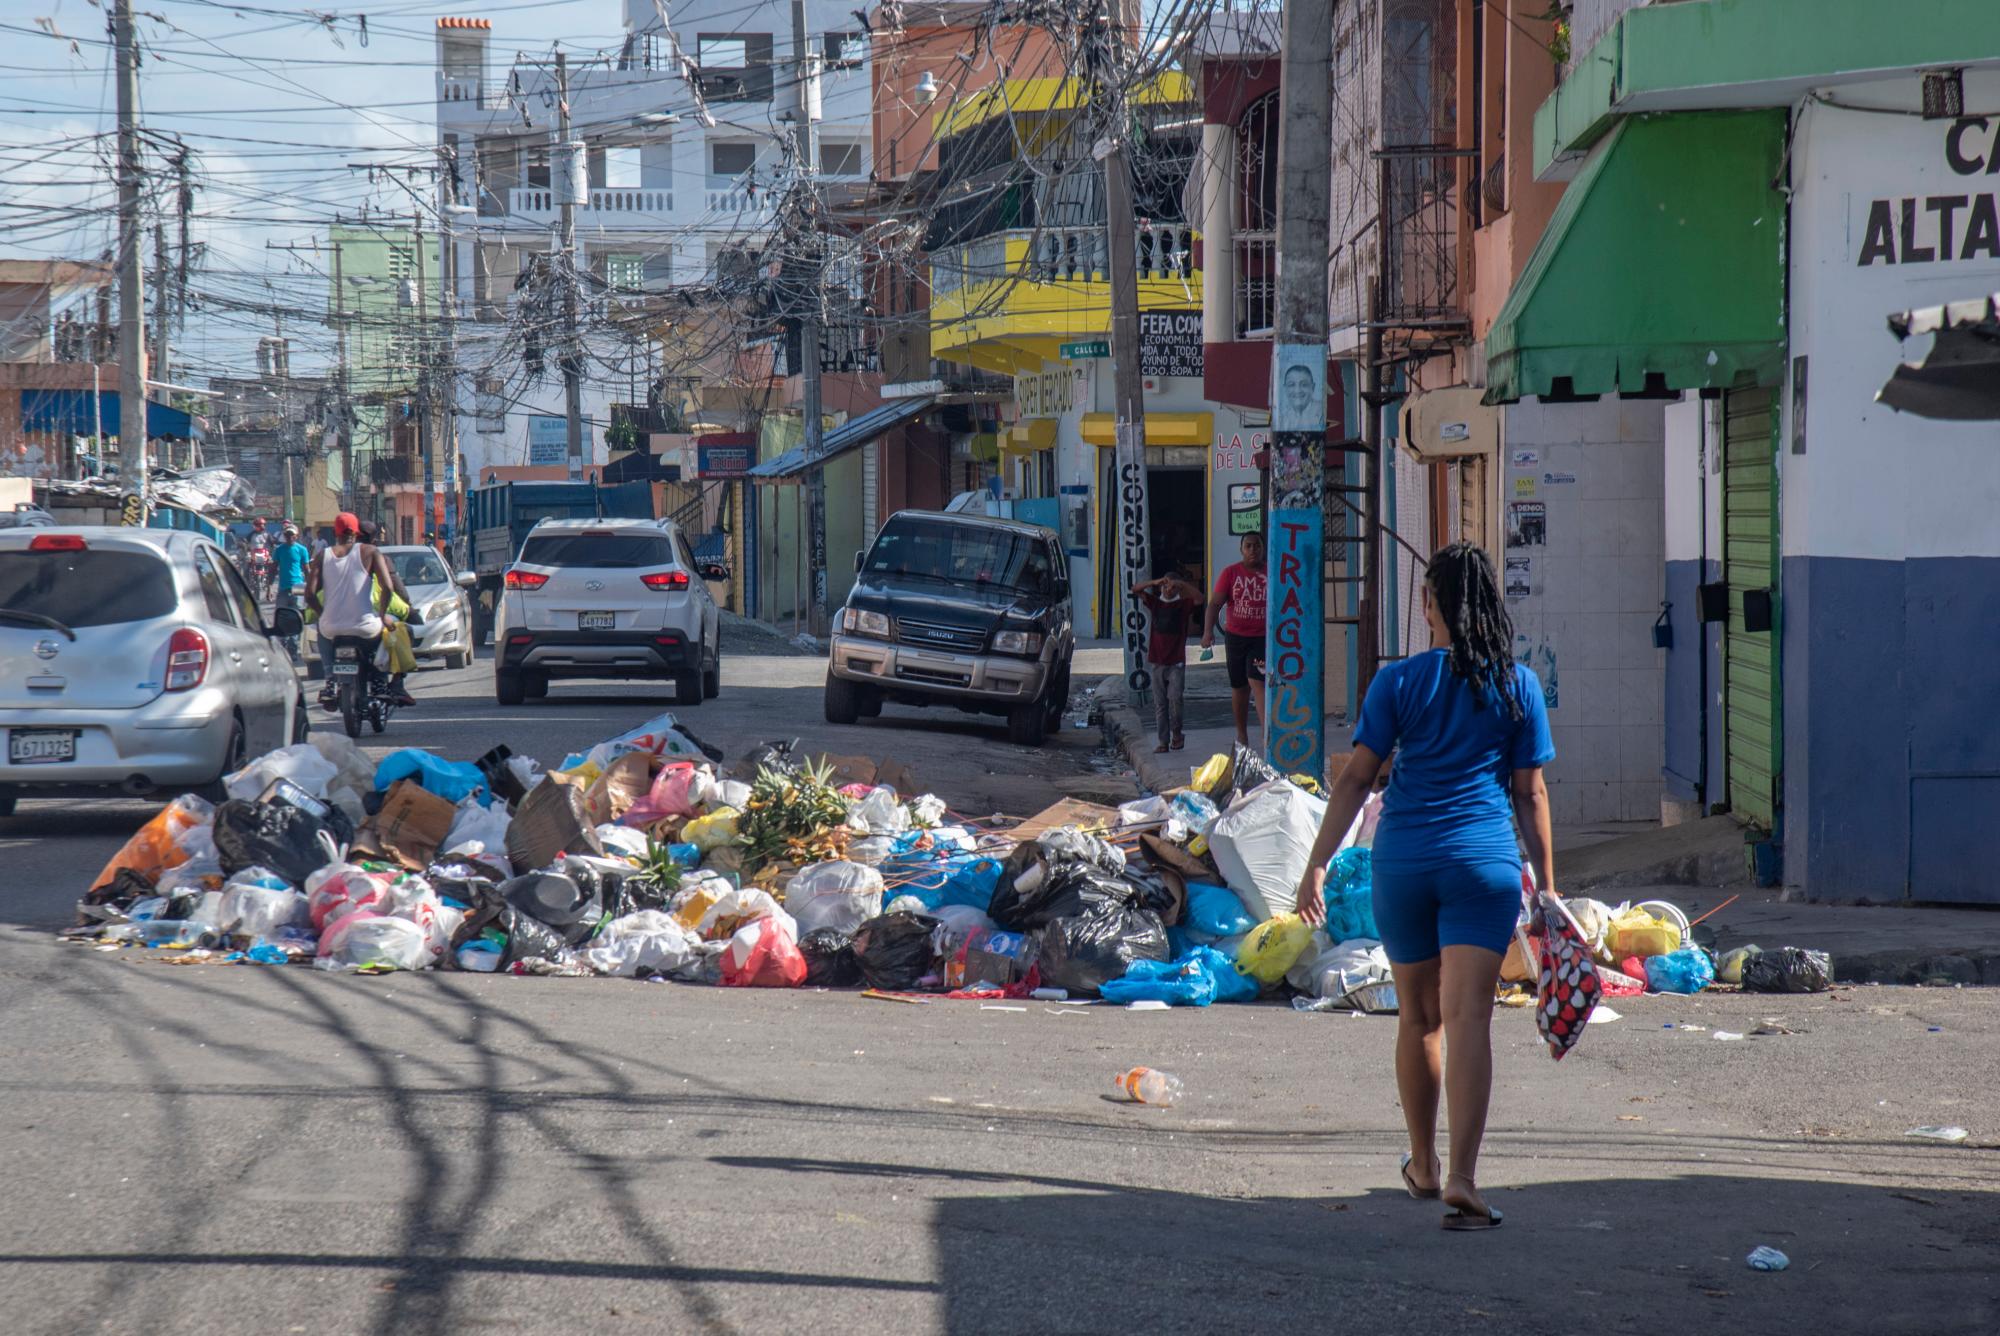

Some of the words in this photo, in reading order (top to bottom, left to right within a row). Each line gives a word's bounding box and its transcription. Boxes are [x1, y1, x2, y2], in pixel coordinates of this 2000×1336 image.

[1857, 193, 2000, 267] ALTA
[1140, 314, 1174, 335] FEFA
[1145, 334, 1191, 345] ECONOMIA
[1140, 345, 1158, 356] MIDA
[1163, 345, 1170, 355] A
[1174, 345, 1198, 356] TODO
[1141, 356, 1168, 366] AYUNO
[1170, 355, 1181, 366] DE
[1170, 366, 1193, 376] SOPA
[1217, 433, 1242, 450] LA
[1216, 452, 1235, 470] DE
[1121, 463, 1152, 691] CONSULTORIO
[1275, 522, 1310, 681] TRAGO
